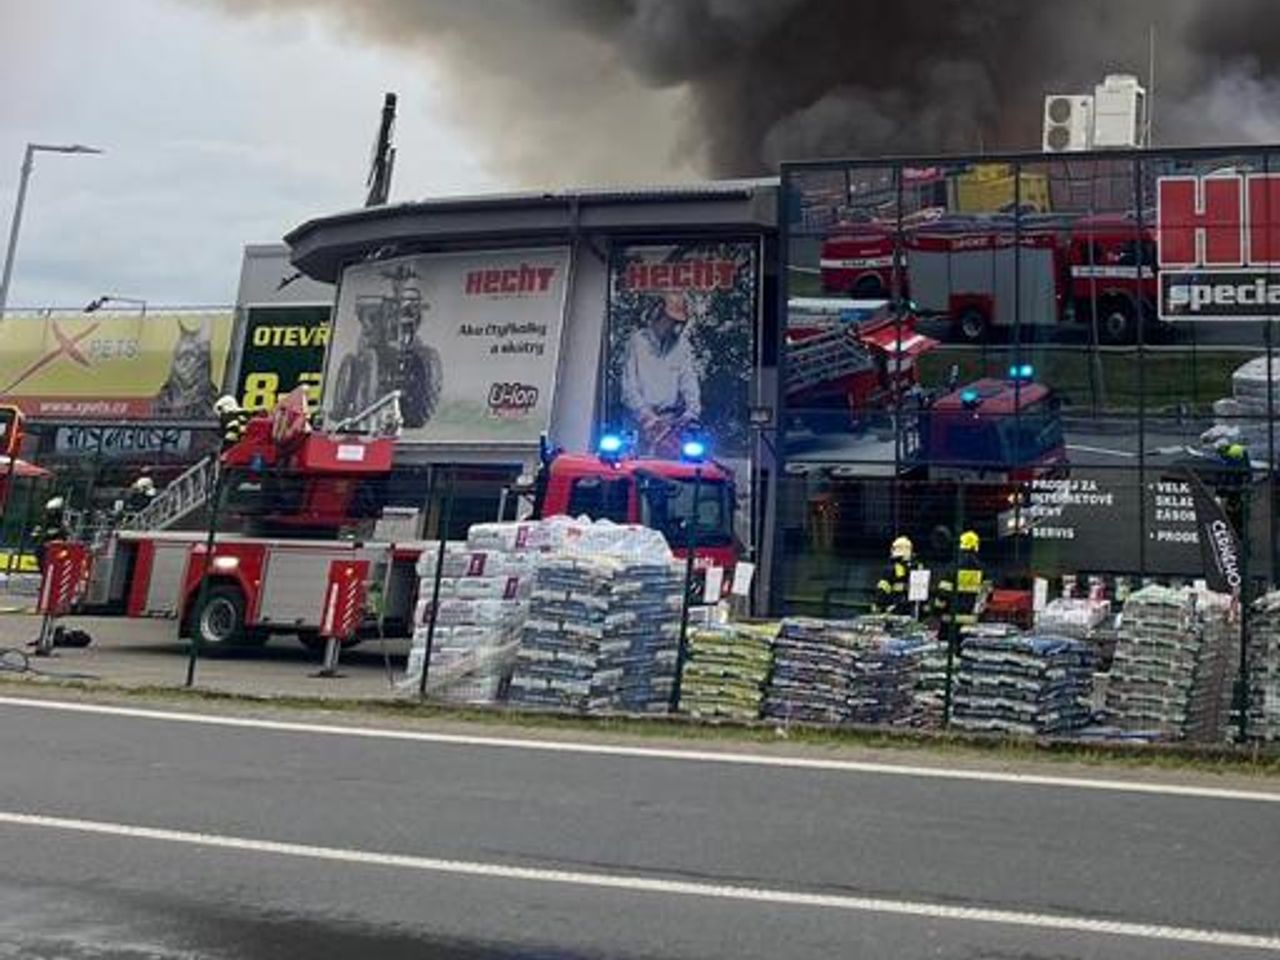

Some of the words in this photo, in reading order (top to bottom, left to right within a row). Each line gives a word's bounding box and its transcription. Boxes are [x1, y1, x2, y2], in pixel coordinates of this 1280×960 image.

[253, 322, 332, 346] OTEVŘ
[1157, 482, 1189, 493] VELK
[1156, 508, 1196, 521] ZÁSOB
[1157, 531, 1199, 543] PRODE
